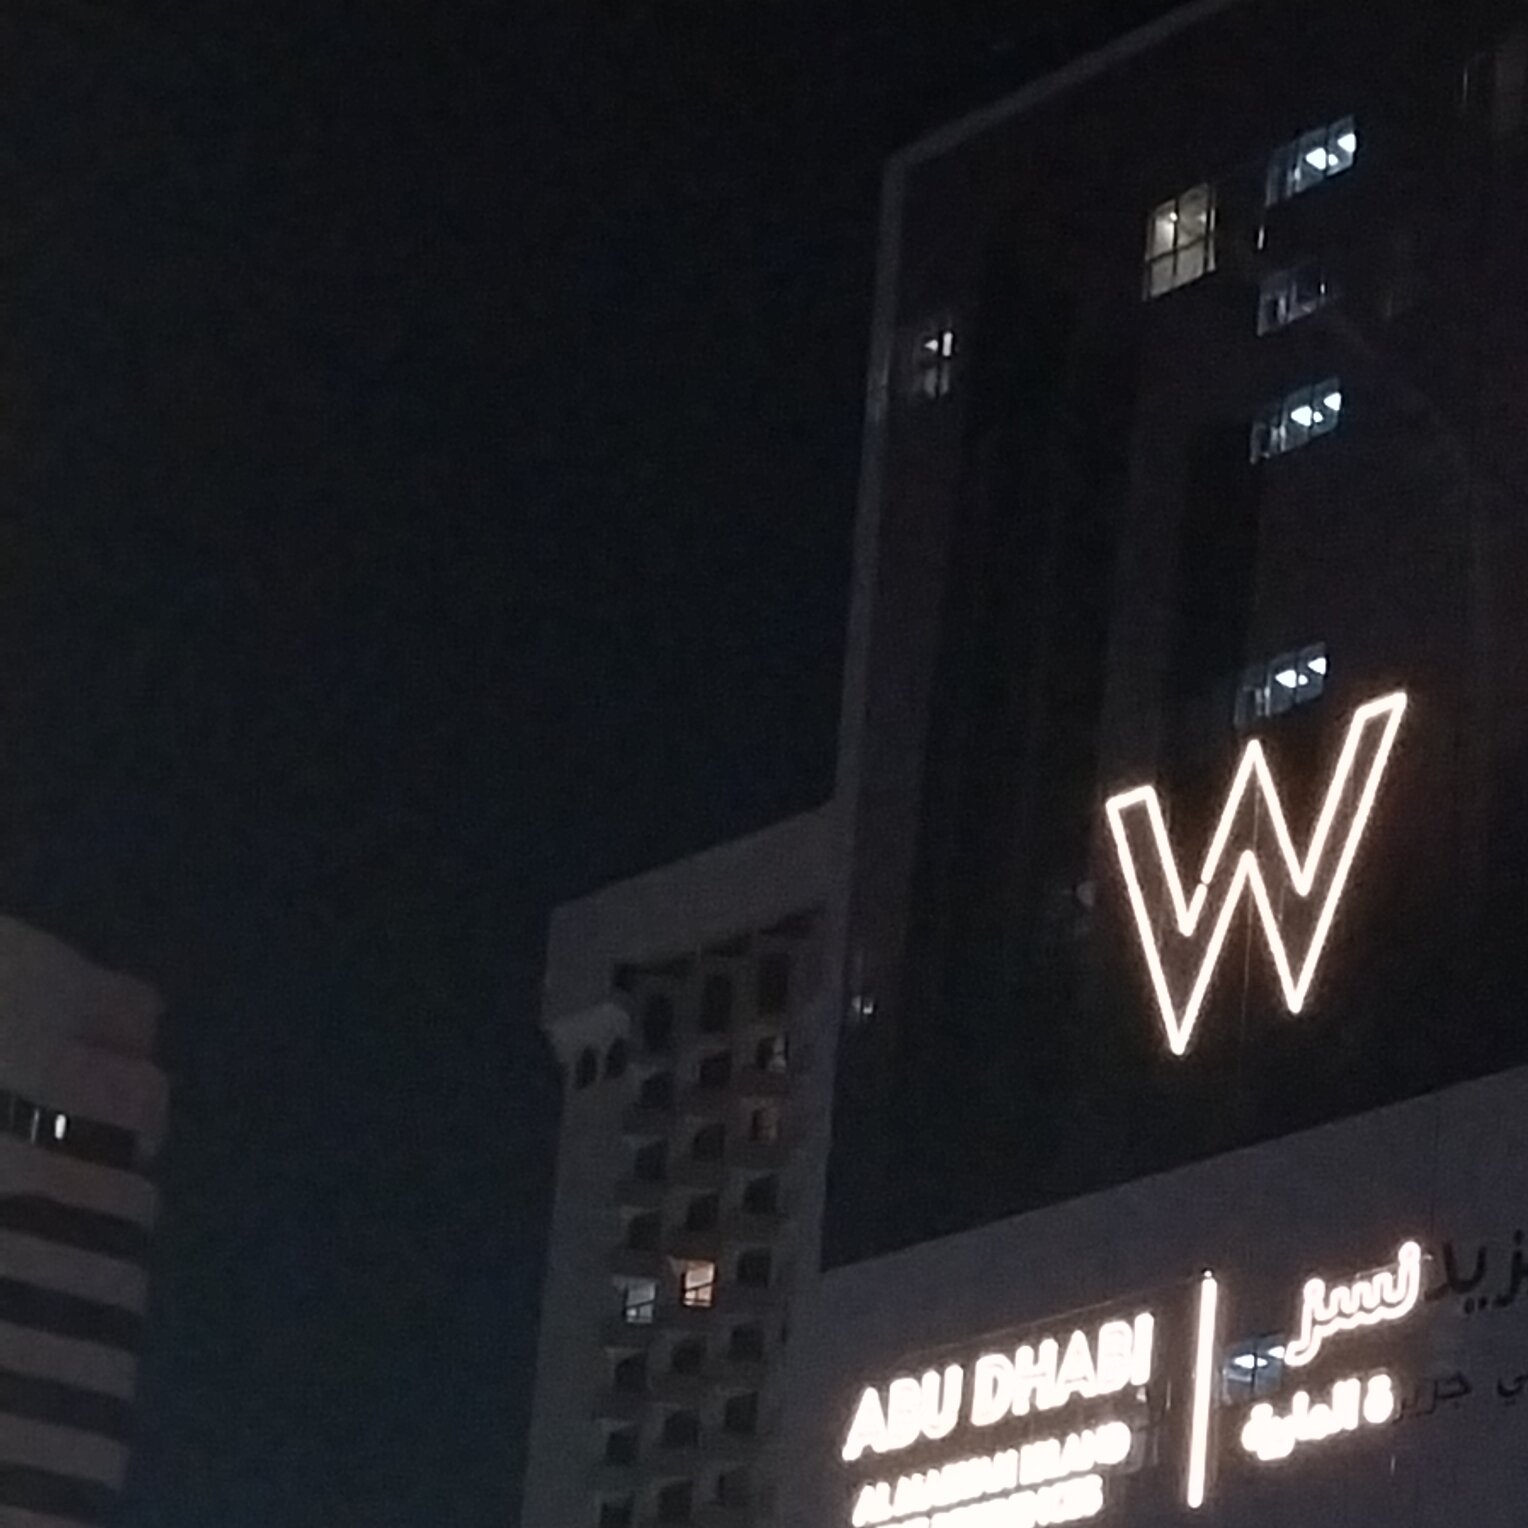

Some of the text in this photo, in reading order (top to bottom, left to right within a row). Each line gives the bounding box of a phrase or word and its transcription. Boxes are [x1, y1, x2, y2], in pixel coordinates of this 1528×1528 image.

[1105, 690, 1408, 1056] W
[842, 1311, 1154, 1461] ABU DHABI
